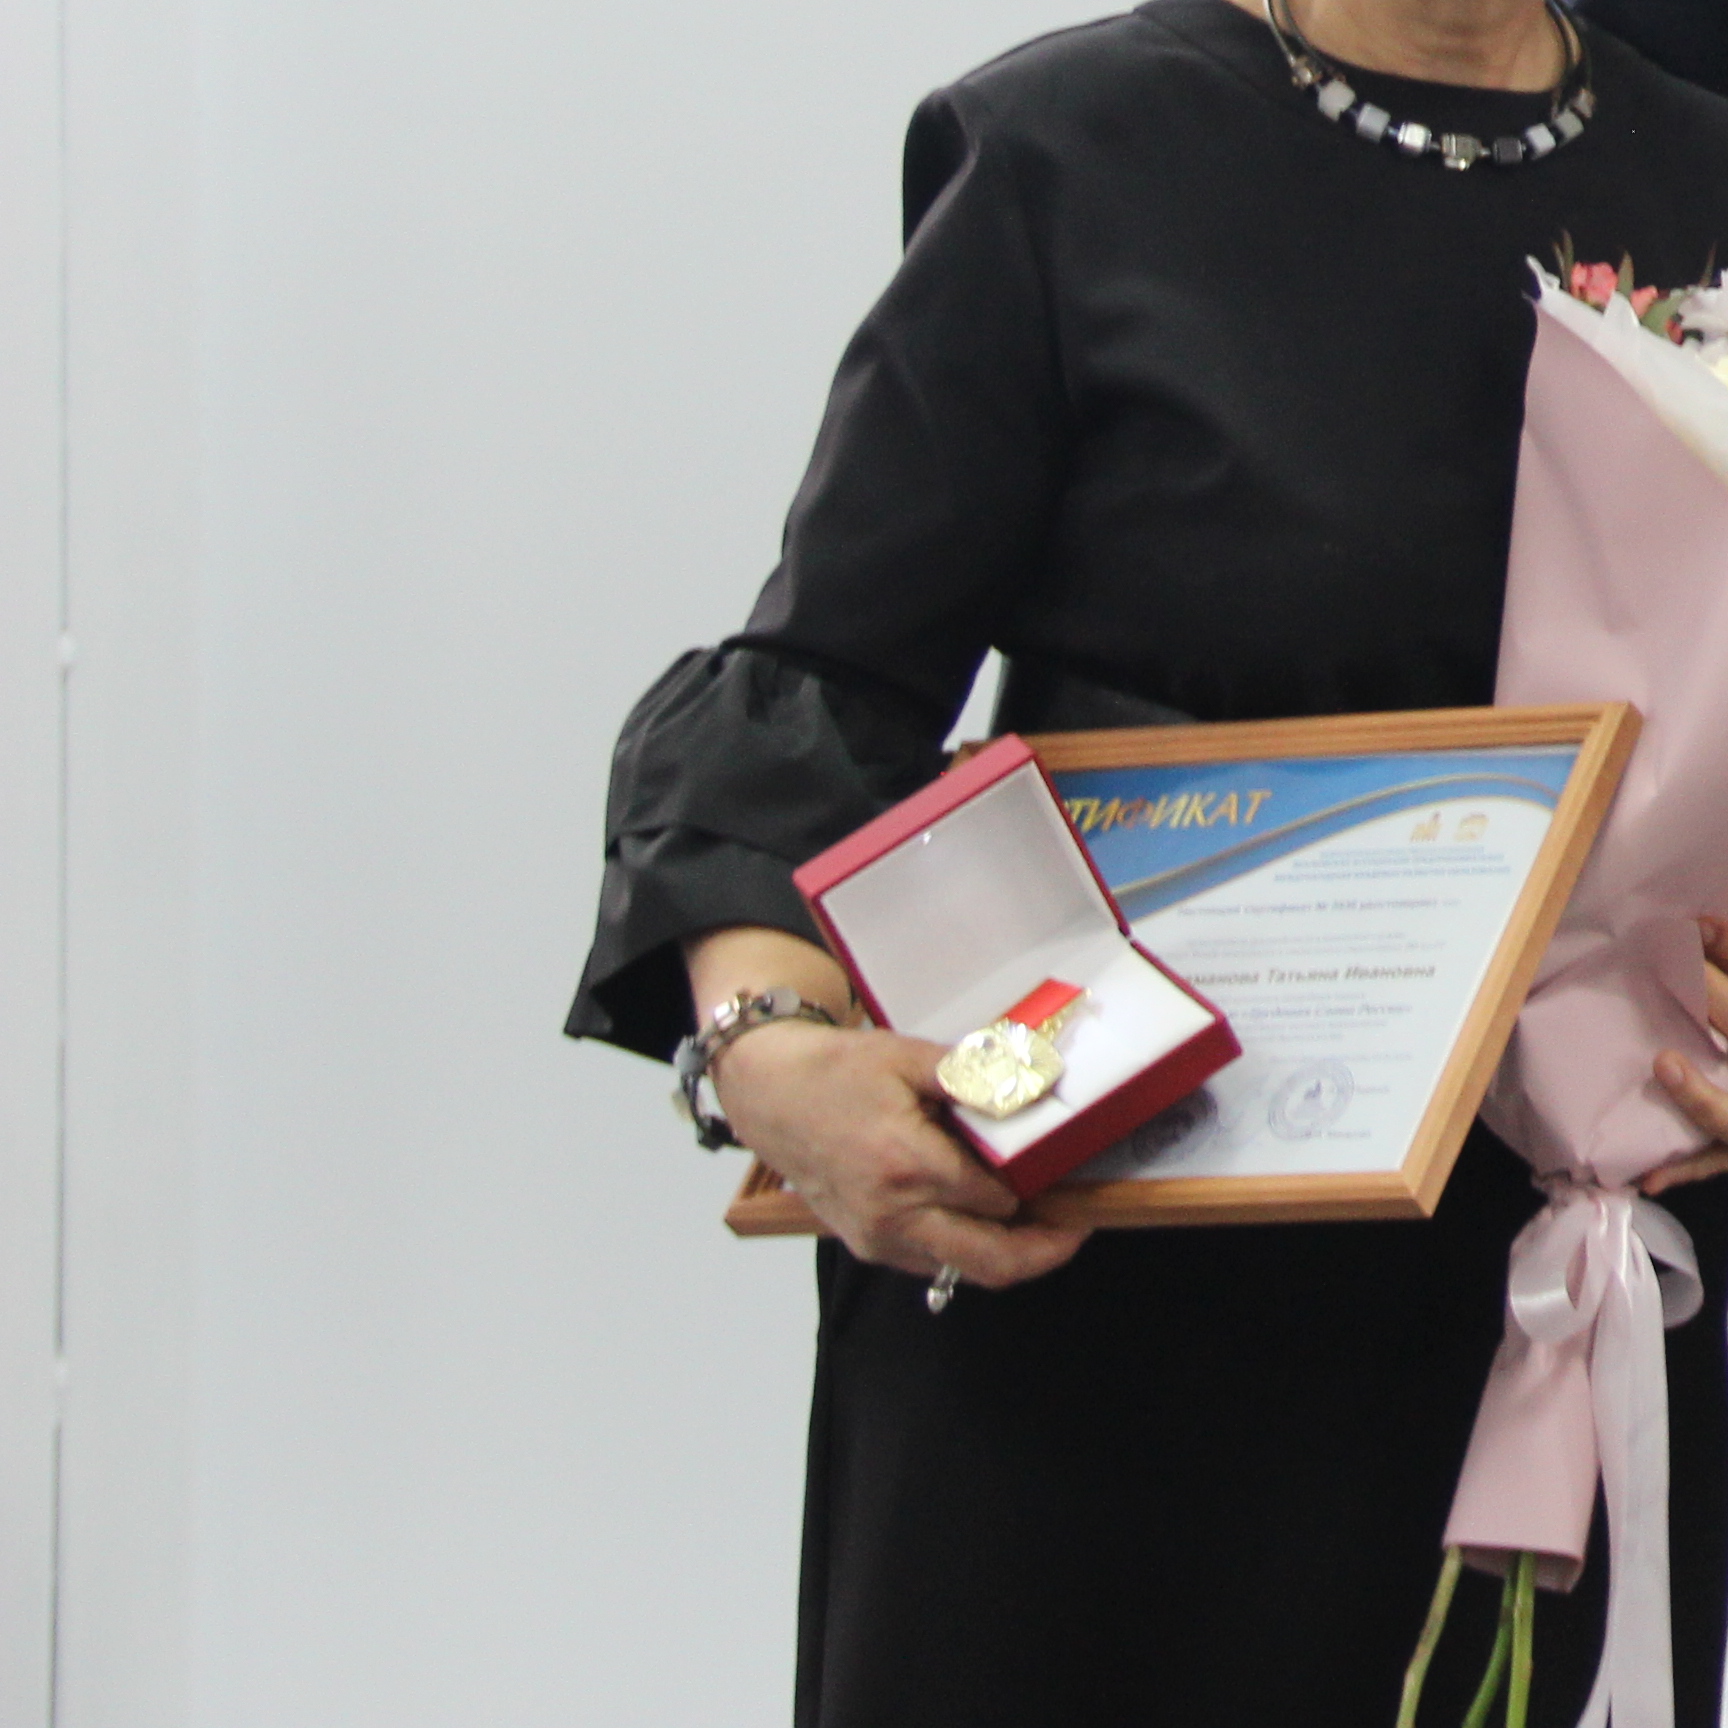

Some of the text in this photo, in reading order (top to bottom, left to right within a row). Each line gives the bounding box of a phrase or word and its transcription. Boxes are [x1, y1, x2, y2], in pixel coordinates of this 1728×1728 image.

[1064, 788, 1273, 833] ТИФИКАТ
[1187, 965, 1436, 986] манова Татьяна Ивановна
